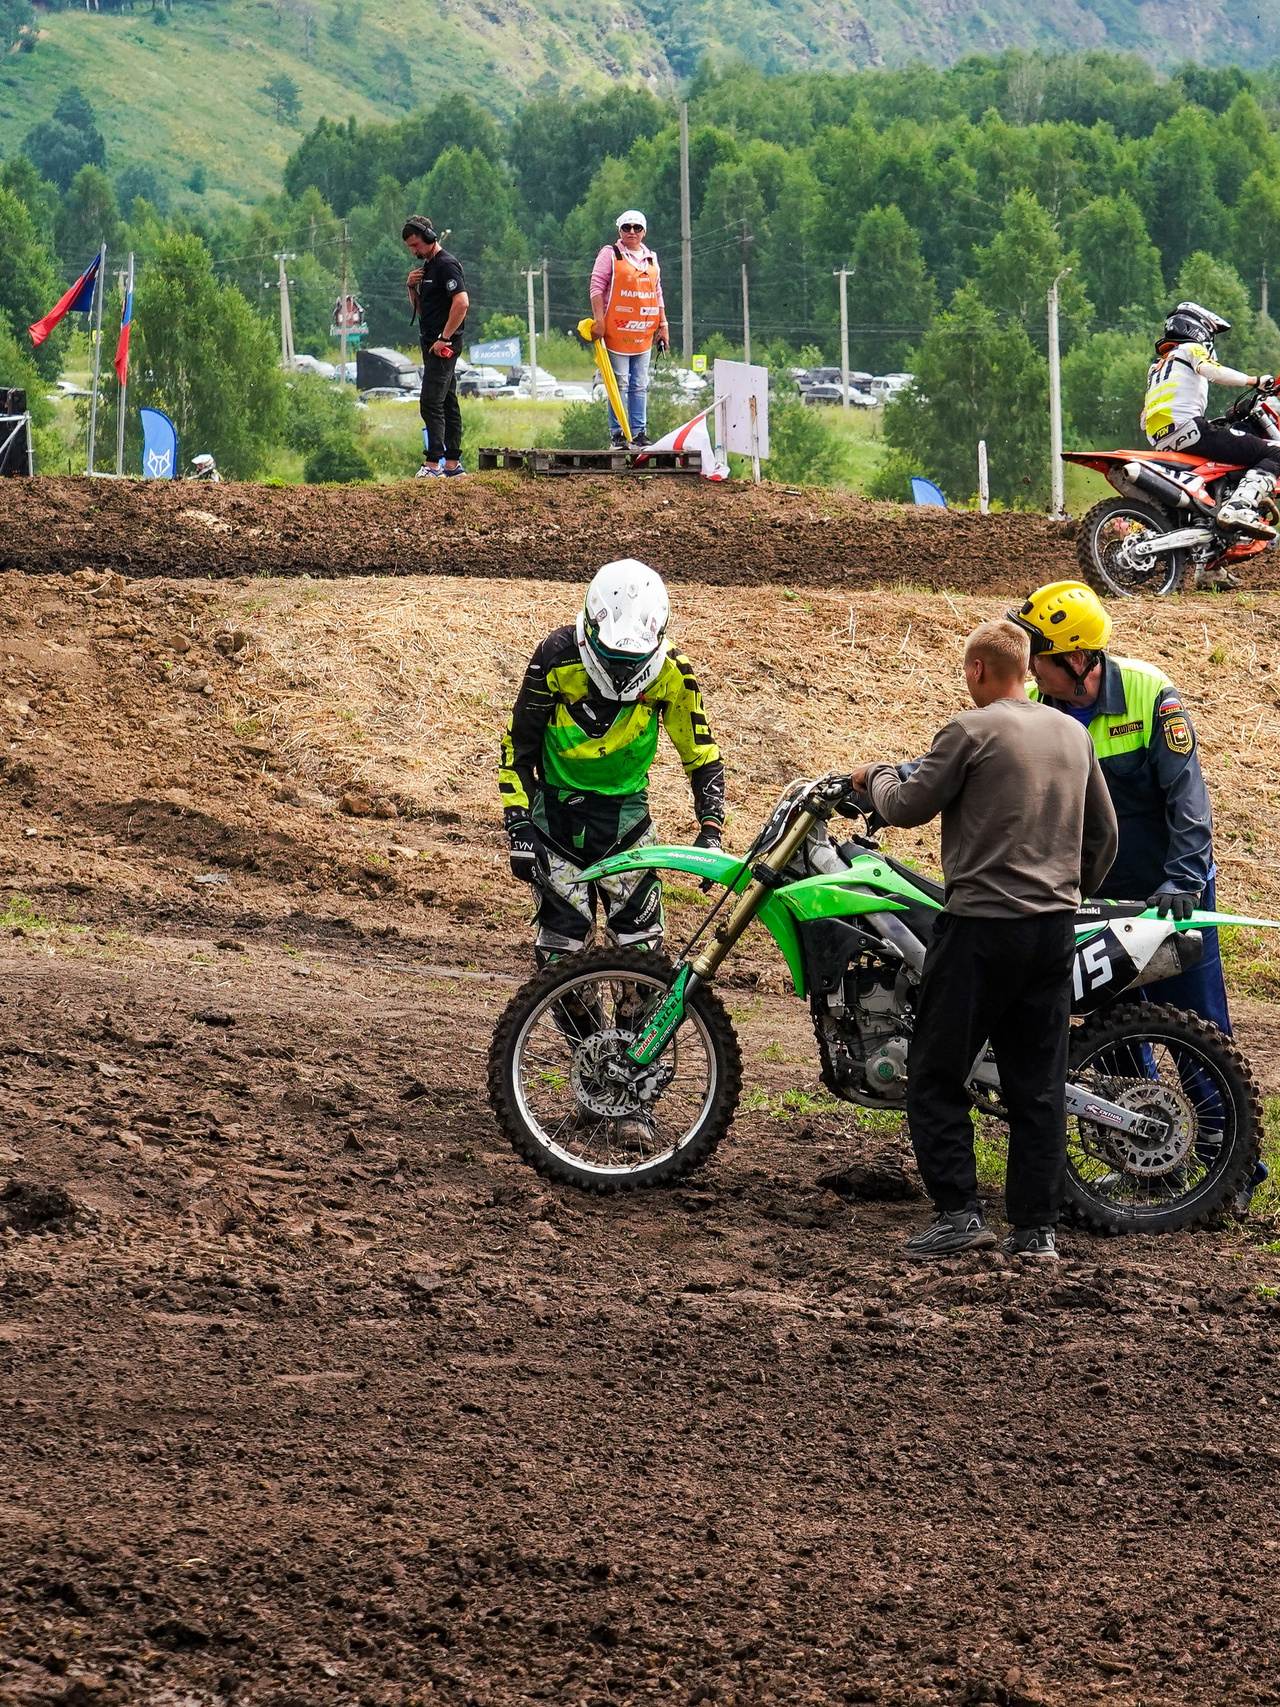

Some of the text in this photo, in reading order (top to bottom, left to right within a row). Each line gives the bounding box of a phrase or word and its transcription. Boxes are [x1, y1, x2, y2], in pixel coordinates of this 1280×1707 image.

[633, 890, 658, 925] Kawasaki
[1075, 906, 1100, 914] asaki
[635, 1028, 659, 1059] BRAKING
